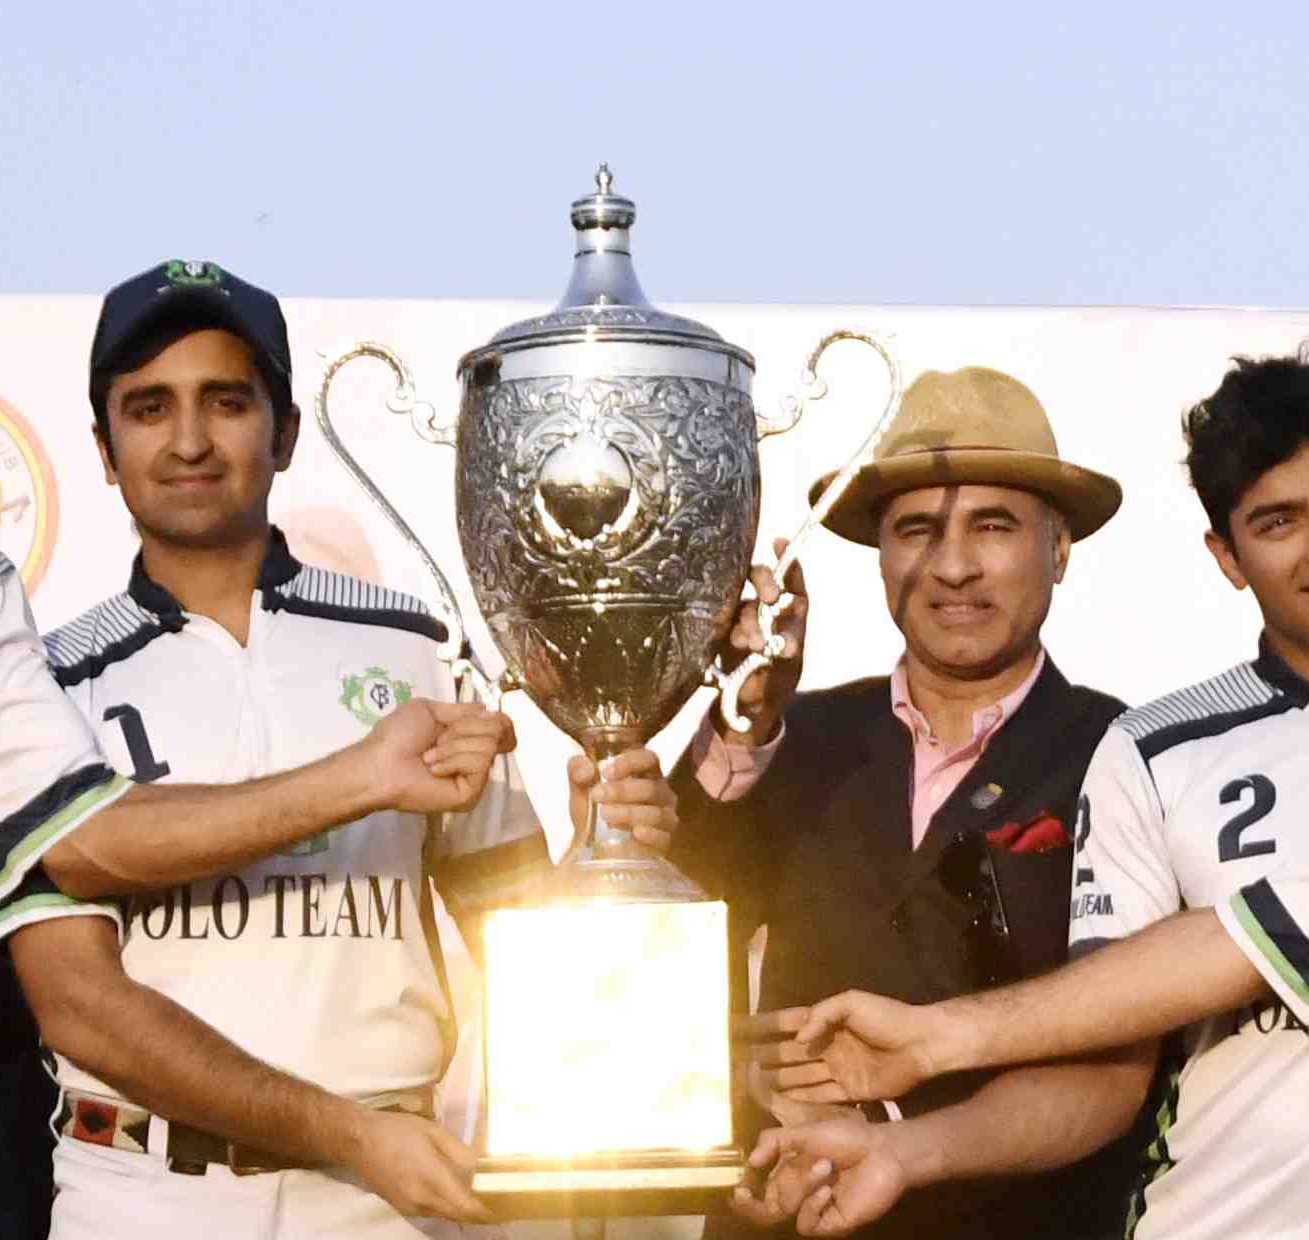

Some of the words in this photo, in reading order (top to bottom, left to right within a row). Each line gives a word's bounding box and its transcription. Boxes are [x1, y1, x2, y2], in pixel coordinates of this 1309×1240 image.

[103, 703, 171, 783] 1
[1217, 772, 1277, 863] 2
[122, 873, 251, 940] OLO
[264, 871, 404, 941] TEAM
